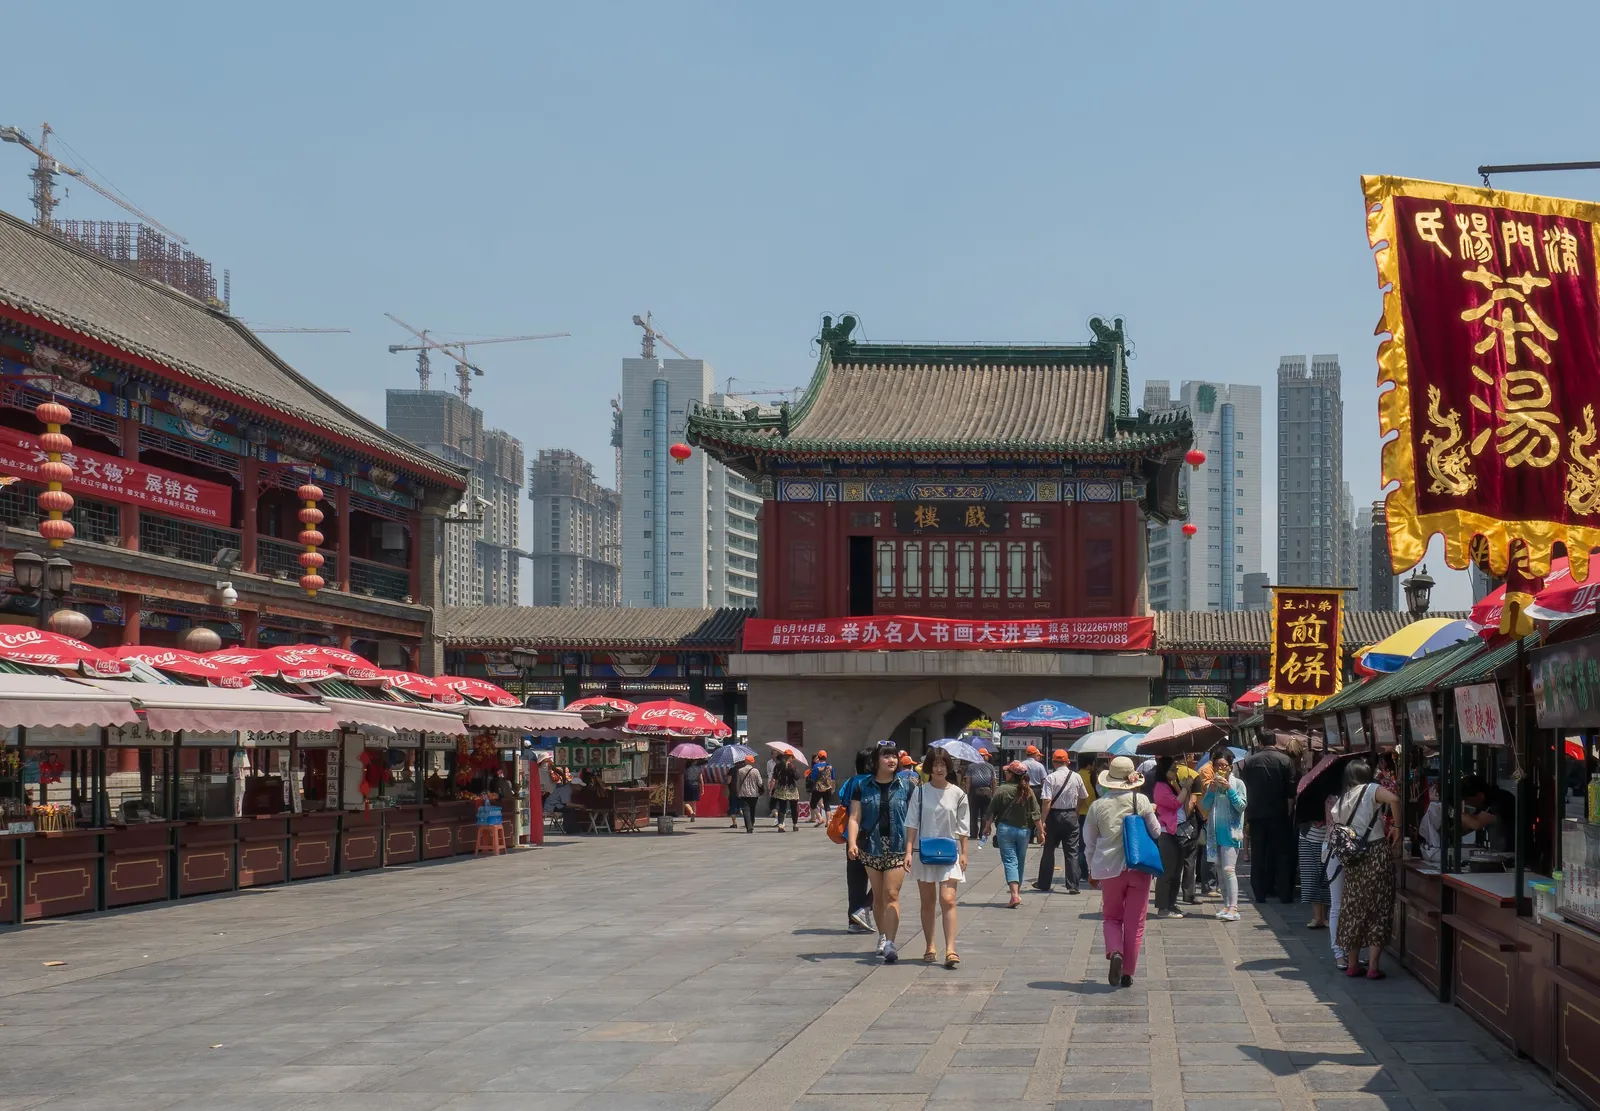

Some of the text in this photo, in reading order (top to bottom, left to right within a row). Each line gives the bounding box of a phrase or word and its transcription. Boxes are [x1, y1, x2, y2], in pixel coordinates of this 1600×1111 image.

[145, 473, 199, 503] 展销会
[771, 634, 836, 645] 周日下午14:30
[841, 621, 1043, 644] 举办名人书画大讲堂
[1072, 634, 1129, 644] 28220088
